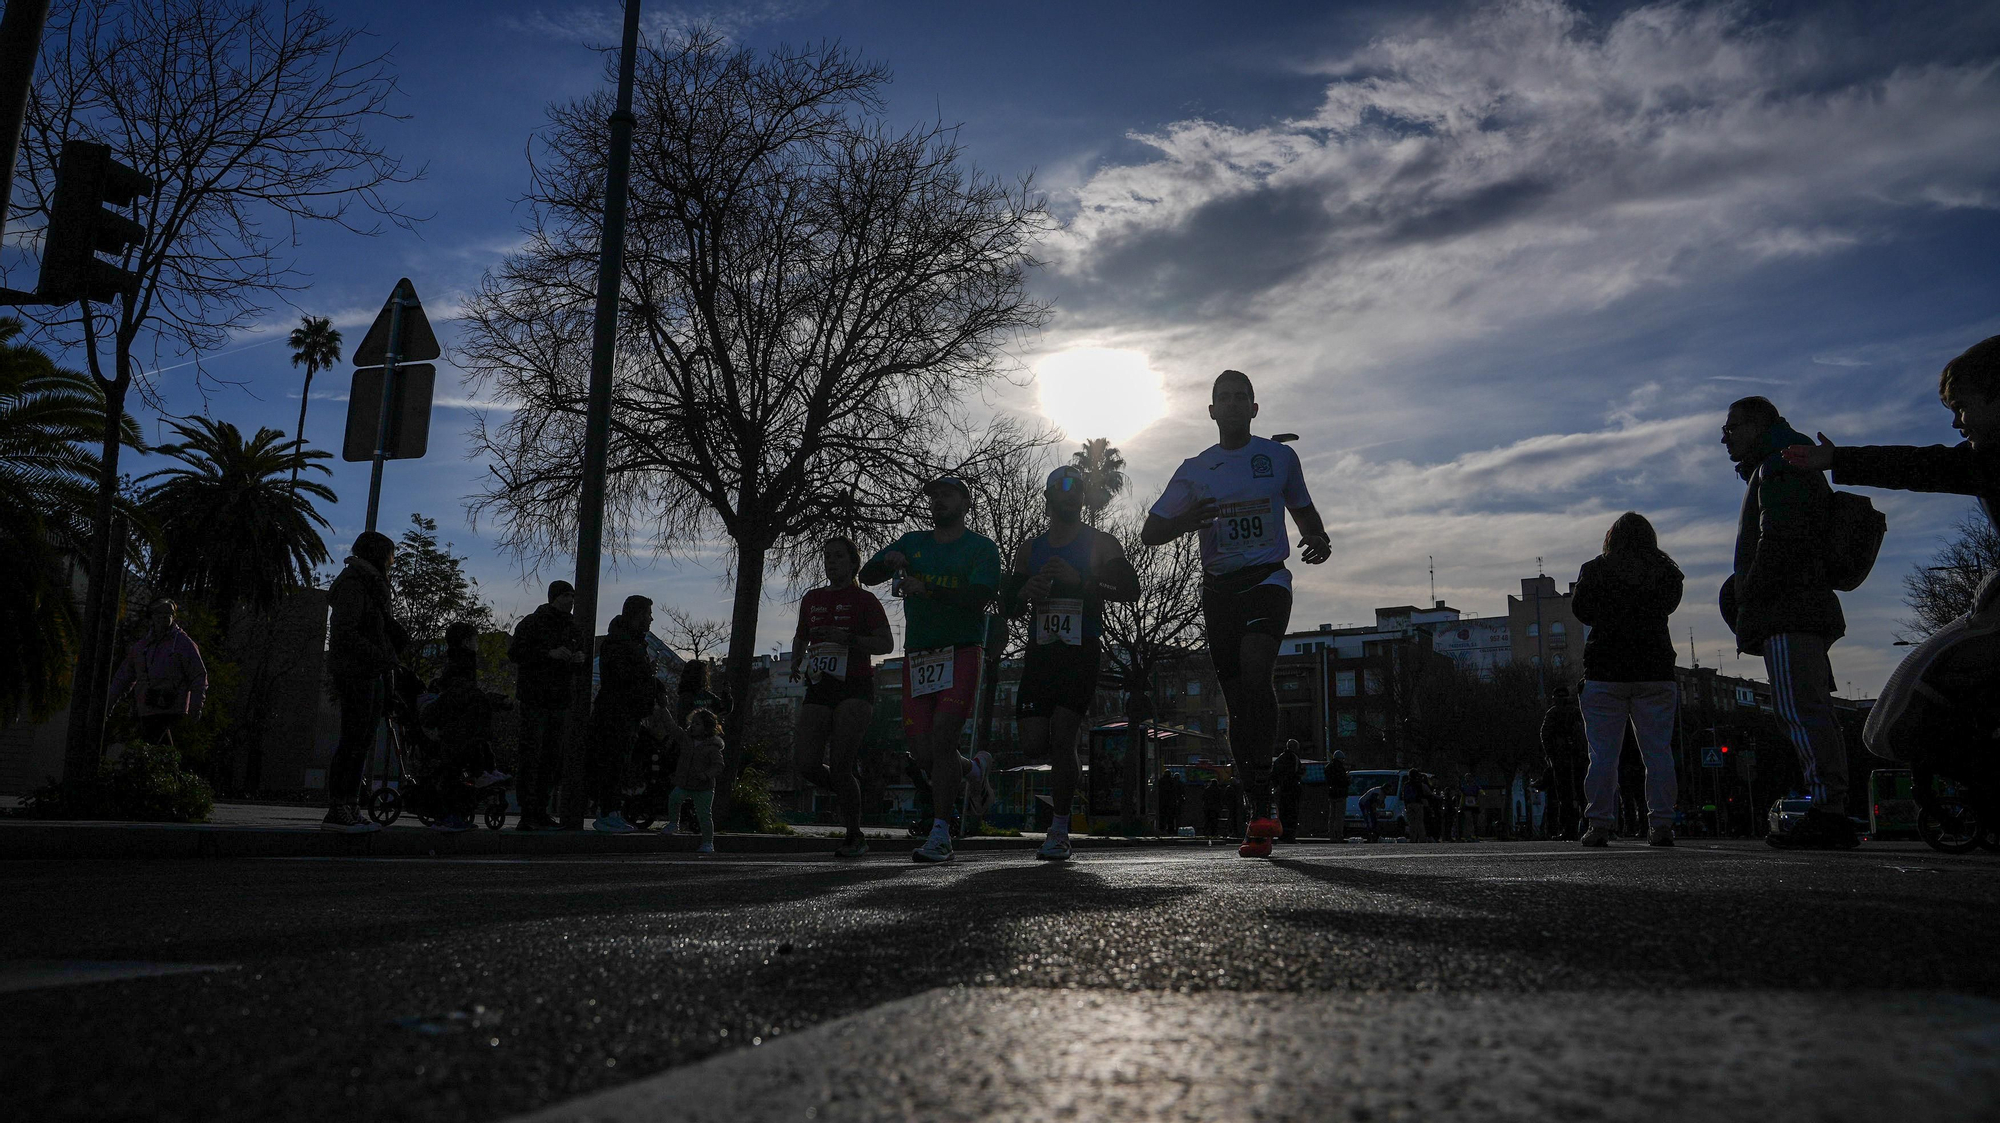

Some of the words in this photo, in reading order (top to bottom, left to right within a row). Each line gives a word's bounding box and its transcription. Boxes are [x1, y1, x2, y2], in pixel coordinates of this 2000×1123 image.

[1228, 516, 1263, 540] 399
[1043, 615, 1071, 634] 494
[812, 656, 838, 673] 350
[918, 663, 945, 685] 327
